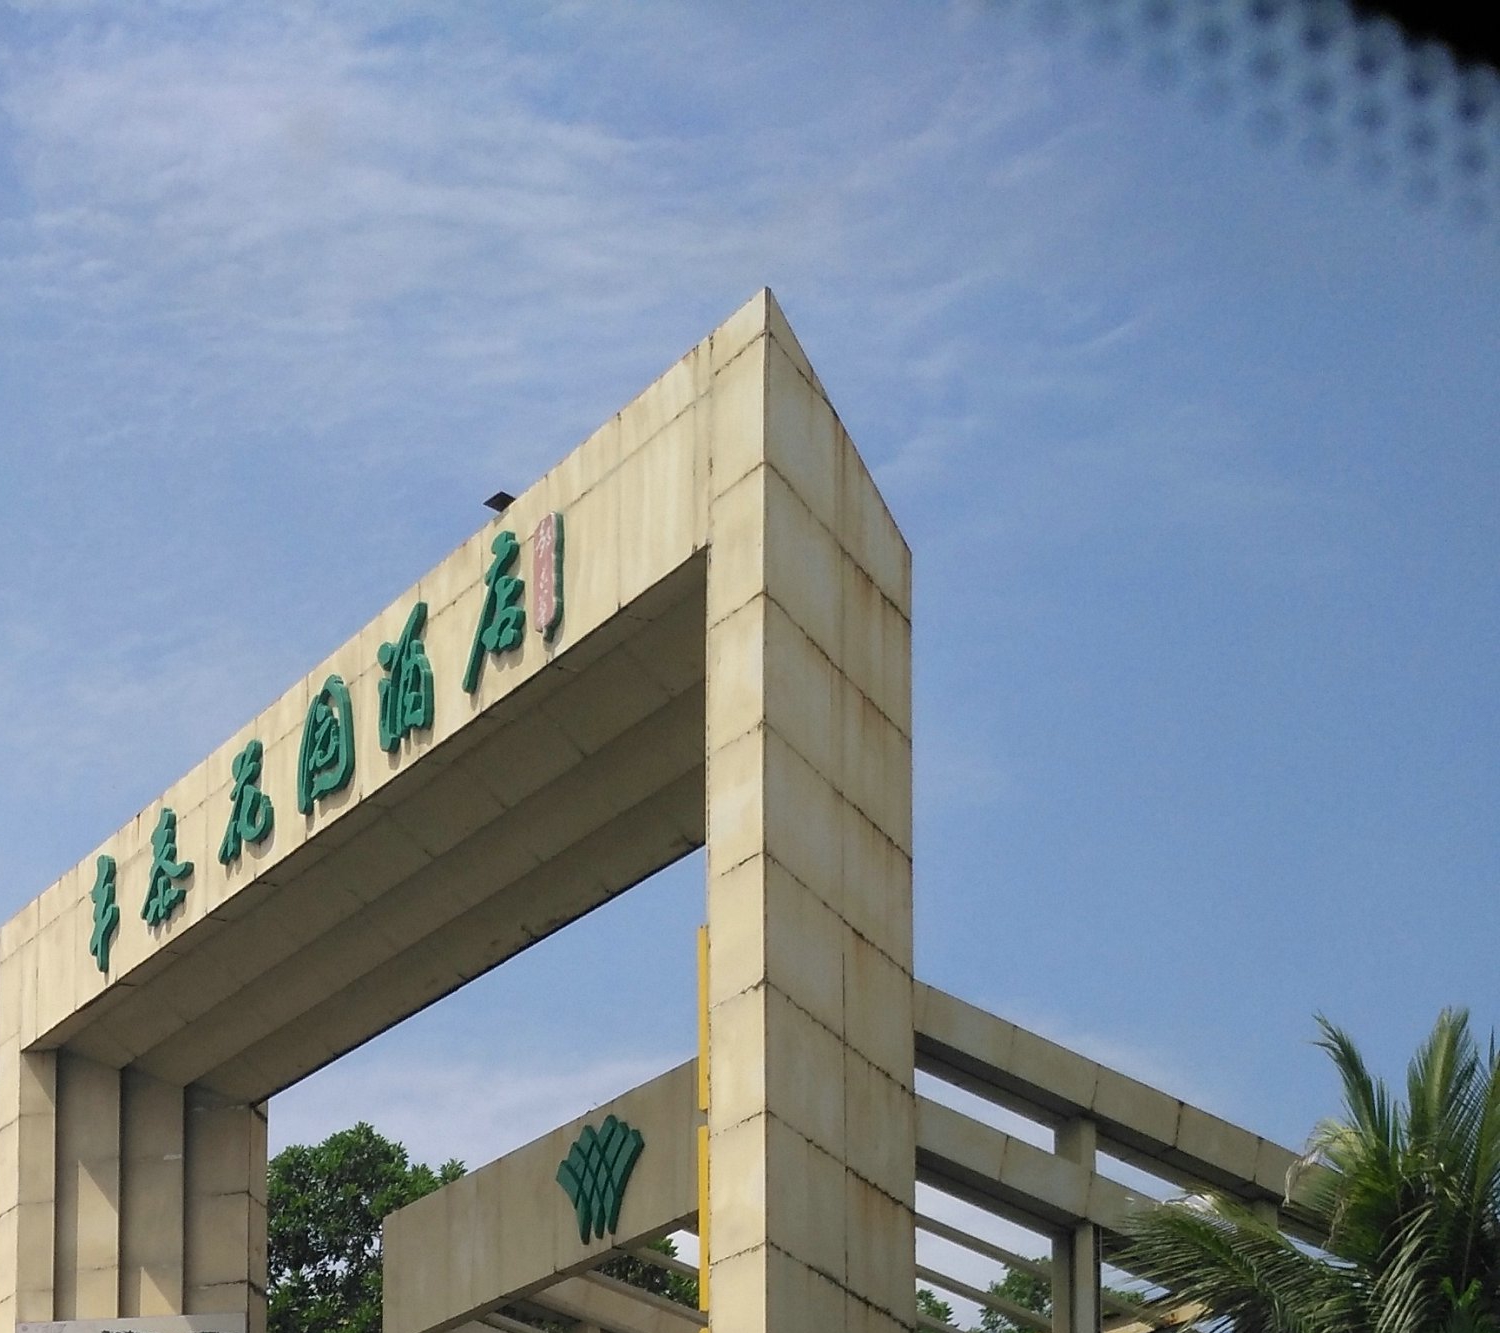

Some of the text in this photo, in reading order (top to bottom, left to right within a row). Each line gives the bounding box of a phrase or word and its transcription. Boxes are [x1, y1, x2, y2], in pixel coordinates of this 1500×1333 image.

[90, 531, 525, 973] 丰泰花园酒店
